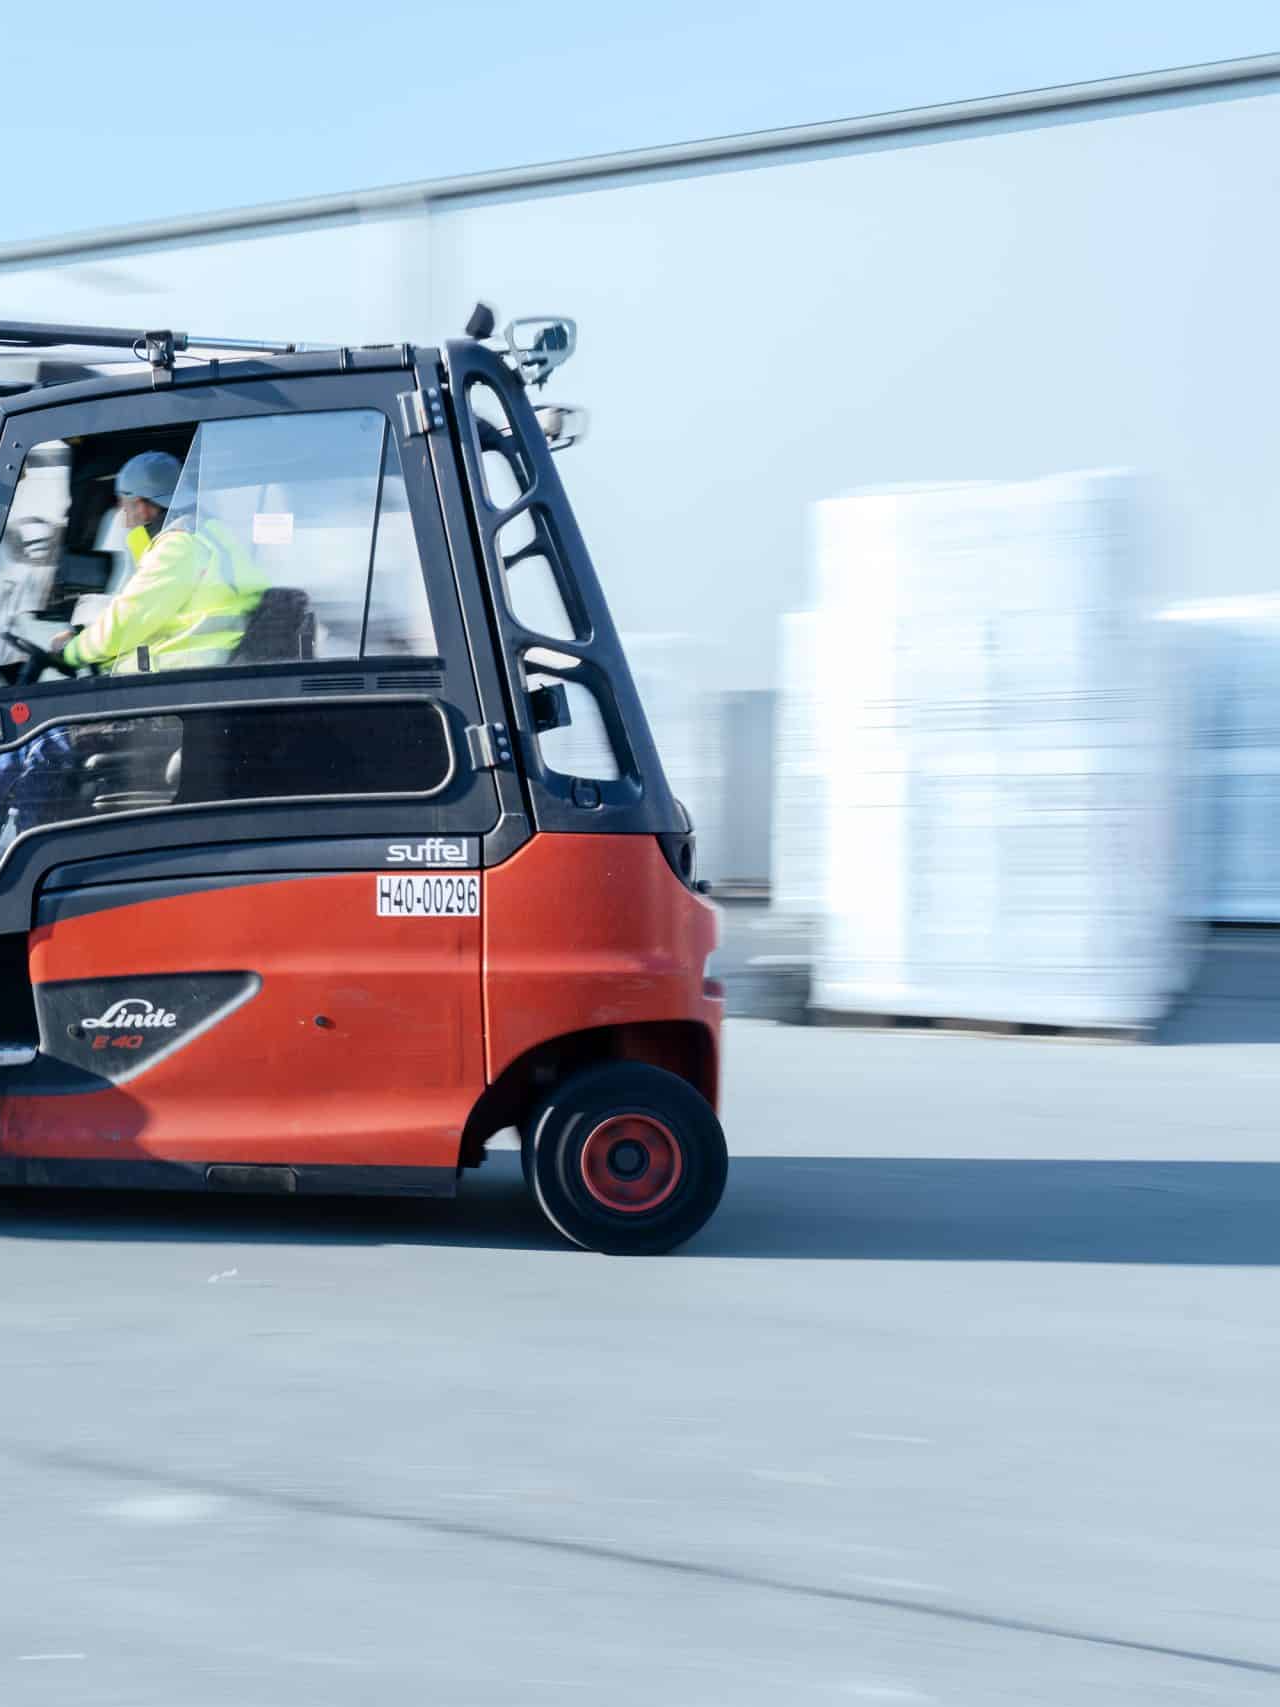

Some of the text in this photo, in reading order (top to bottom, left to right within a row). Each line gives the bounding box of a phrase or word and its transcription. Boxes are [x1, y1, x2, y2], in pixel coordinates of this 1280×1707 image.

[385, 838, 468, 862] suffel
[380, 877, 478, 914] H40-00296
[81, 998, 177, 1029] Linde
[92, 1034, 144, 1049] E 40
